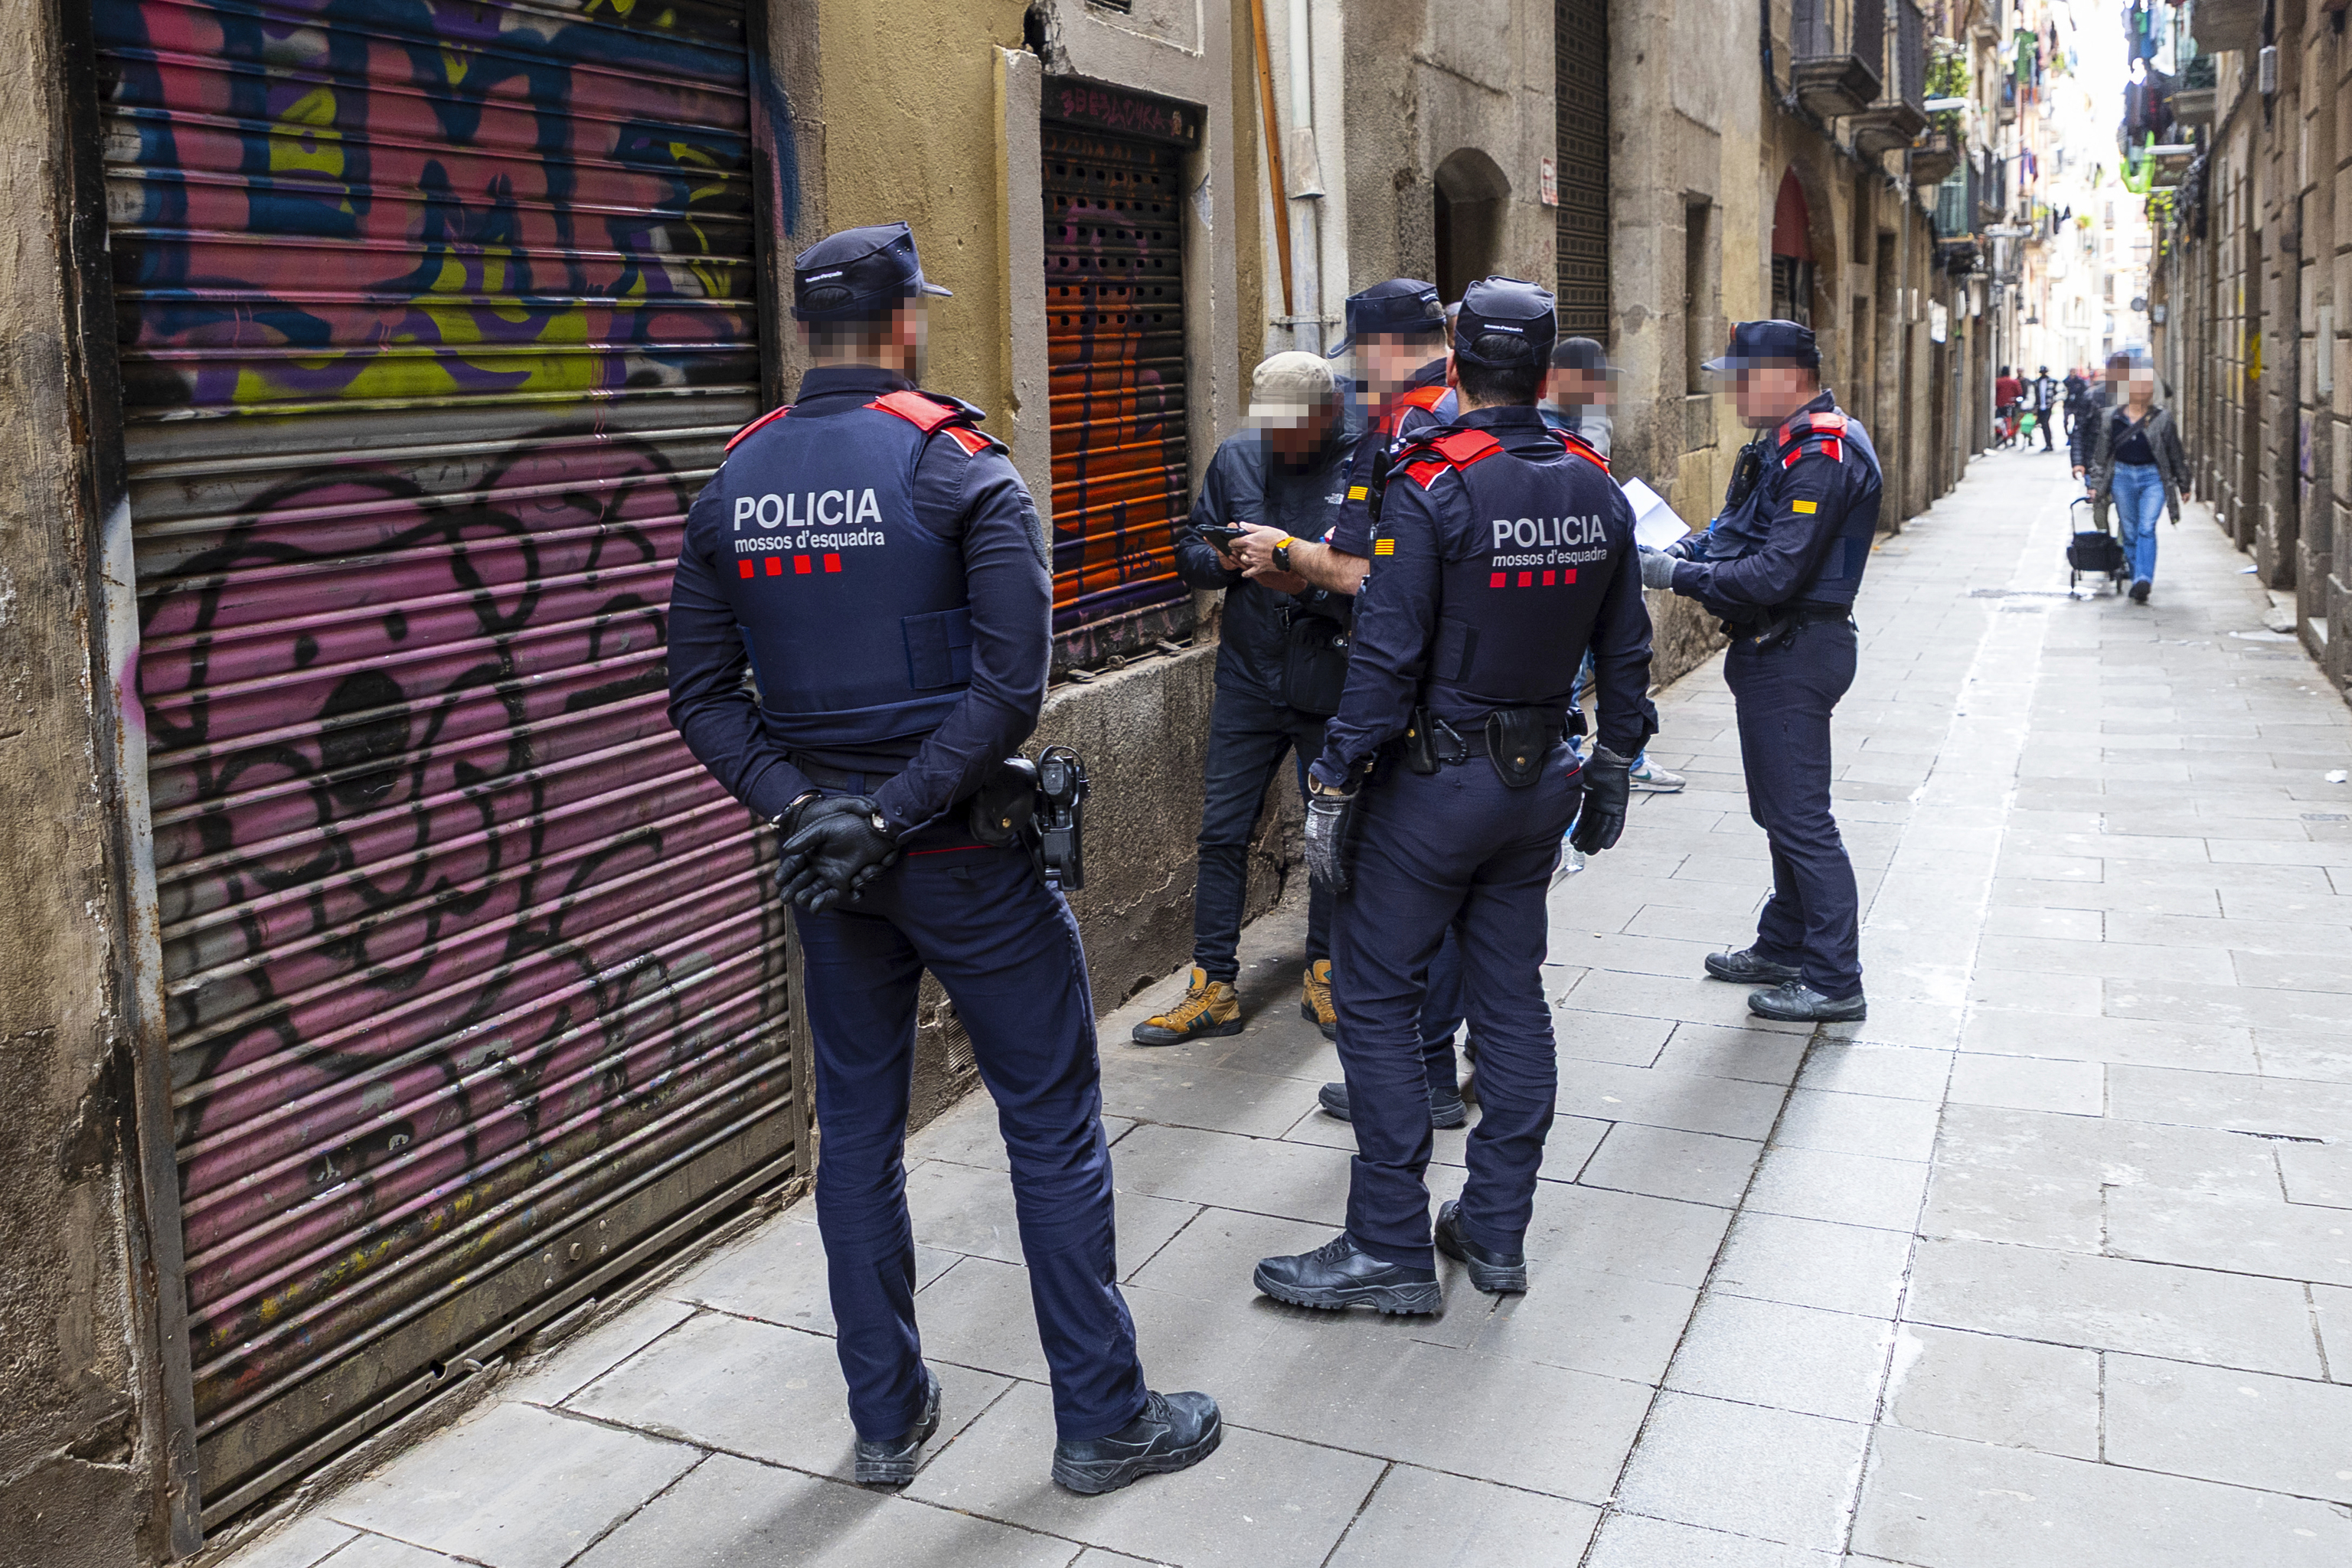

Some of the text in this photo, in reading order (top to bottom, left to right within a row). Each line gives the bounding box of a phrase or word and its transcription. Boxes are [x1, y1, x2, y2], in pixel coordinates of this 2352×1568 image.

[733, 488, 883, 531] POLICIA
[734, 527, 885, 553] mossos d'esquadra
[1492, 514, 1607, 549] POLICIA
[1492, 546, 1607, 567] mossos d'esquadra
